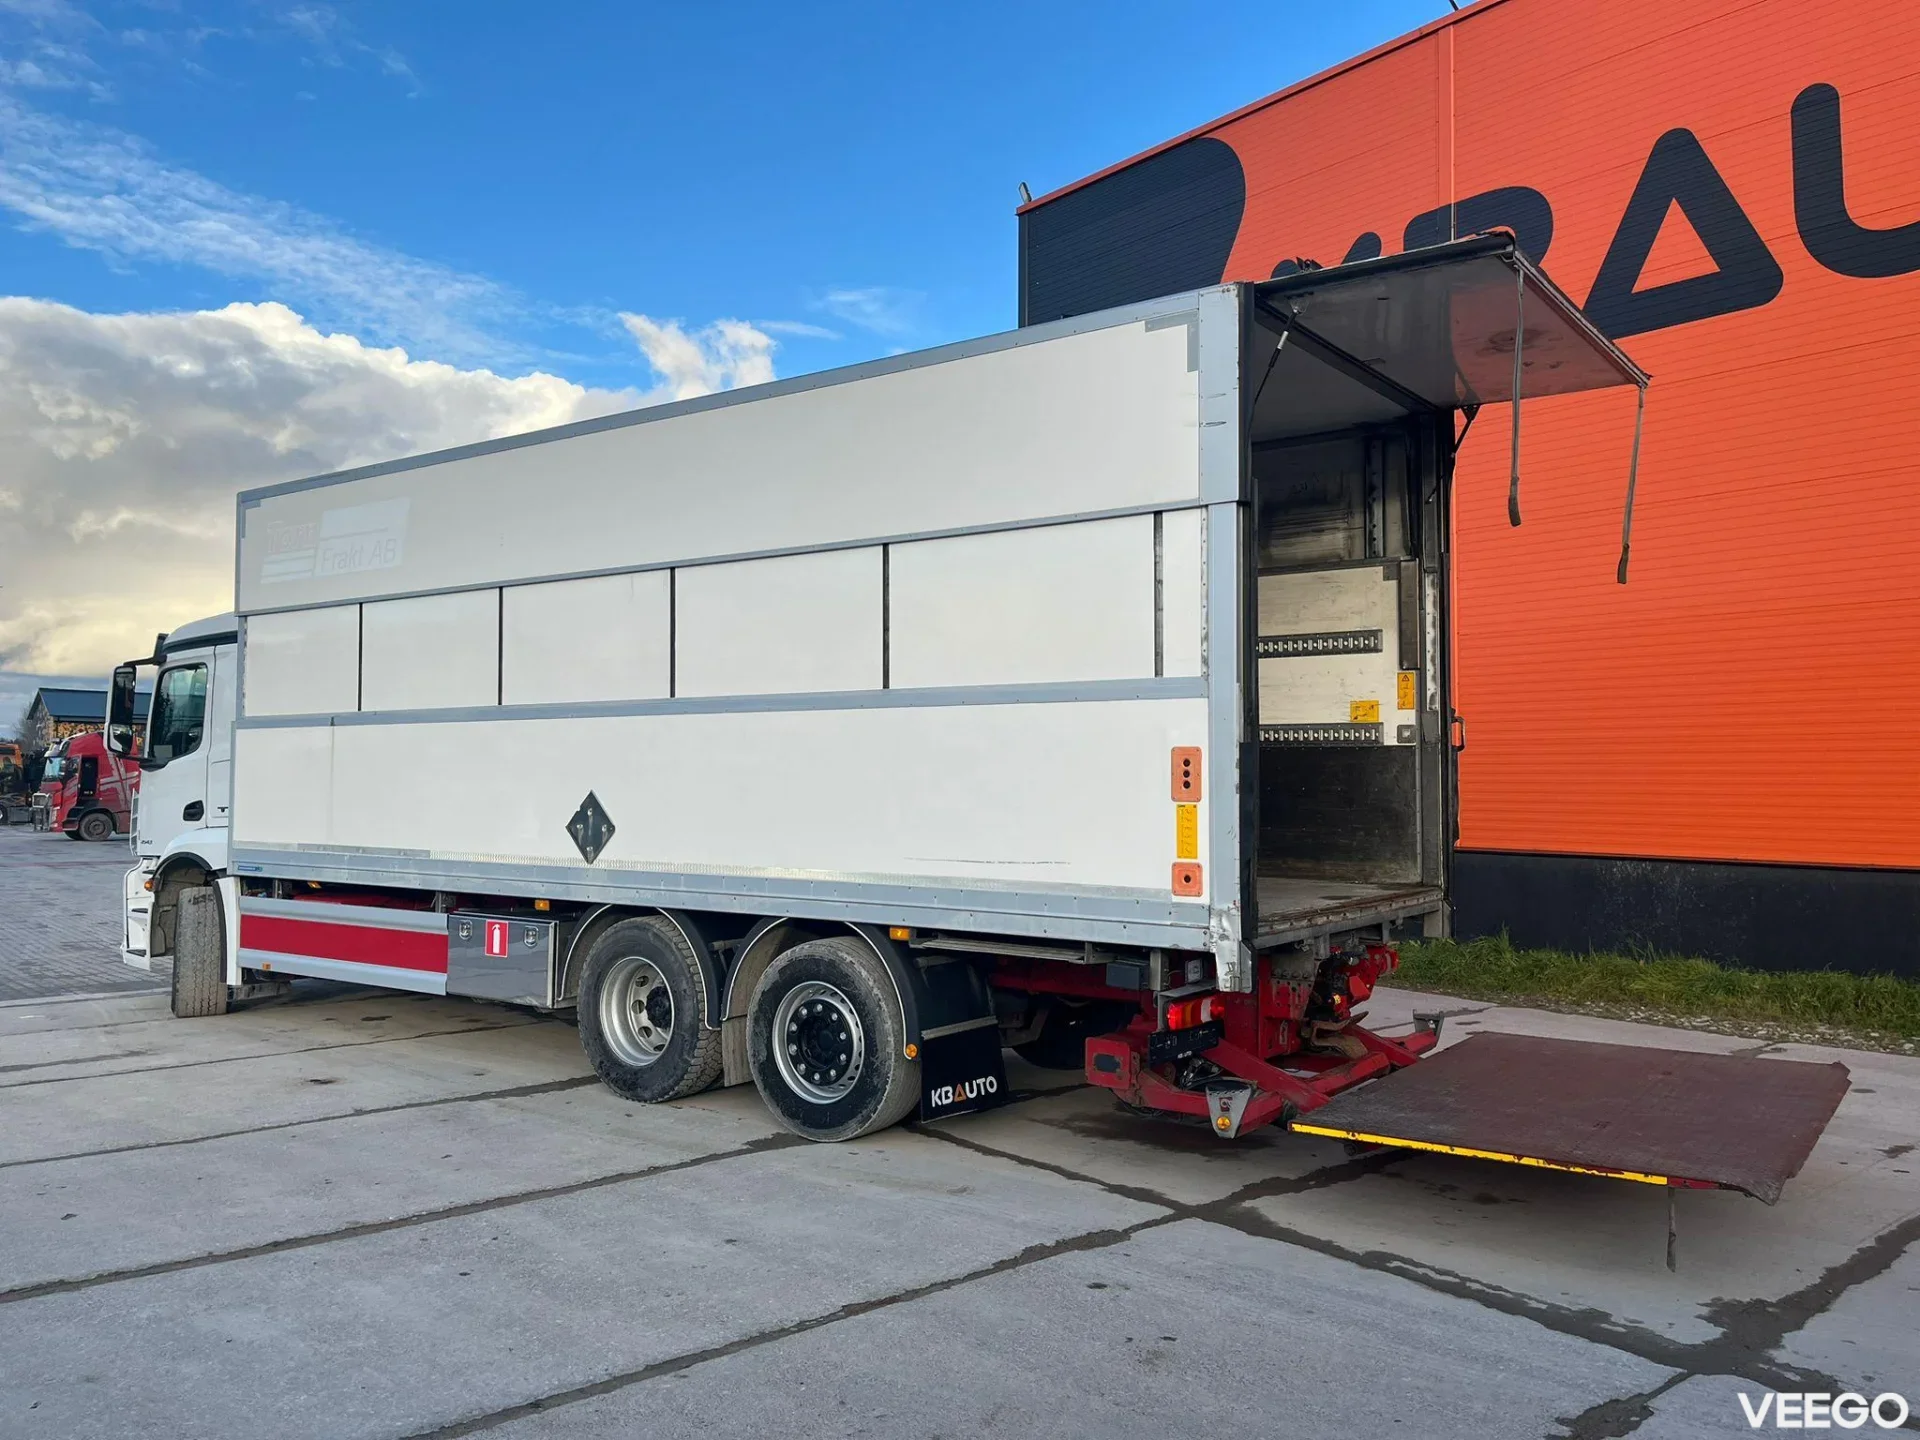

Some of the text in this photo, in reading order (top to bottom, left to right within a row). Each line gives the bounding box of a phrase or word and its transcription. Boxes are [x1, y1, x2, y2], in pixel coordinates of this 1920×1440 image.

[320, 537, 397, 572] Frakt AB
[931, 1075, 998, 1108] KBAUTO
